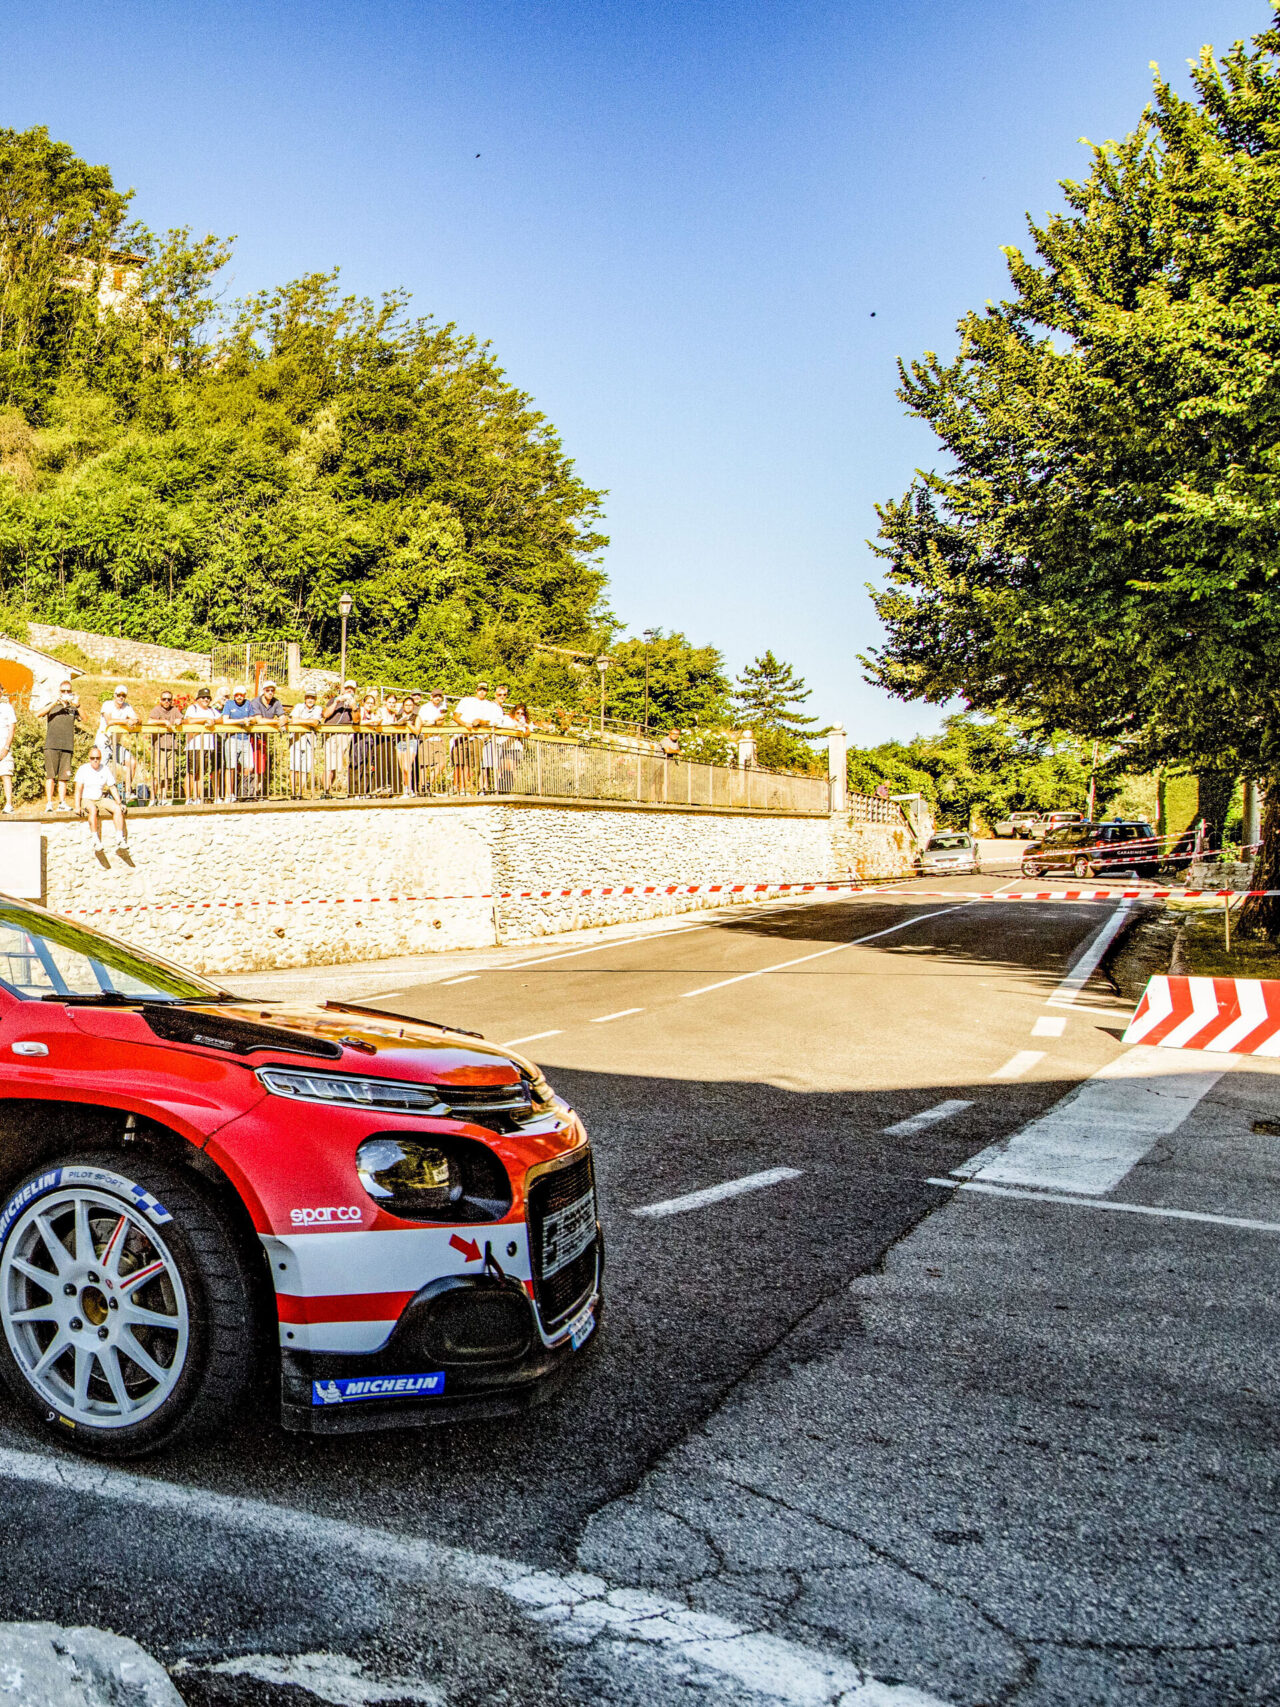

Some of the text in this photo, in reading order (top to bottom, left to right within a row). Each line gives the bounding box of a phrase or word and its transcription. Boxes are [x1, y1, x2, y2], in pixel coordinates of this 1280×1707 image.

[68, 1171, 94, 1180] PILOT
[94, 1173, 125, 1189] SPORT
[289, 1206, 363, 1227] sparco
[345, 1376, 439, 1395] MICHELIN
